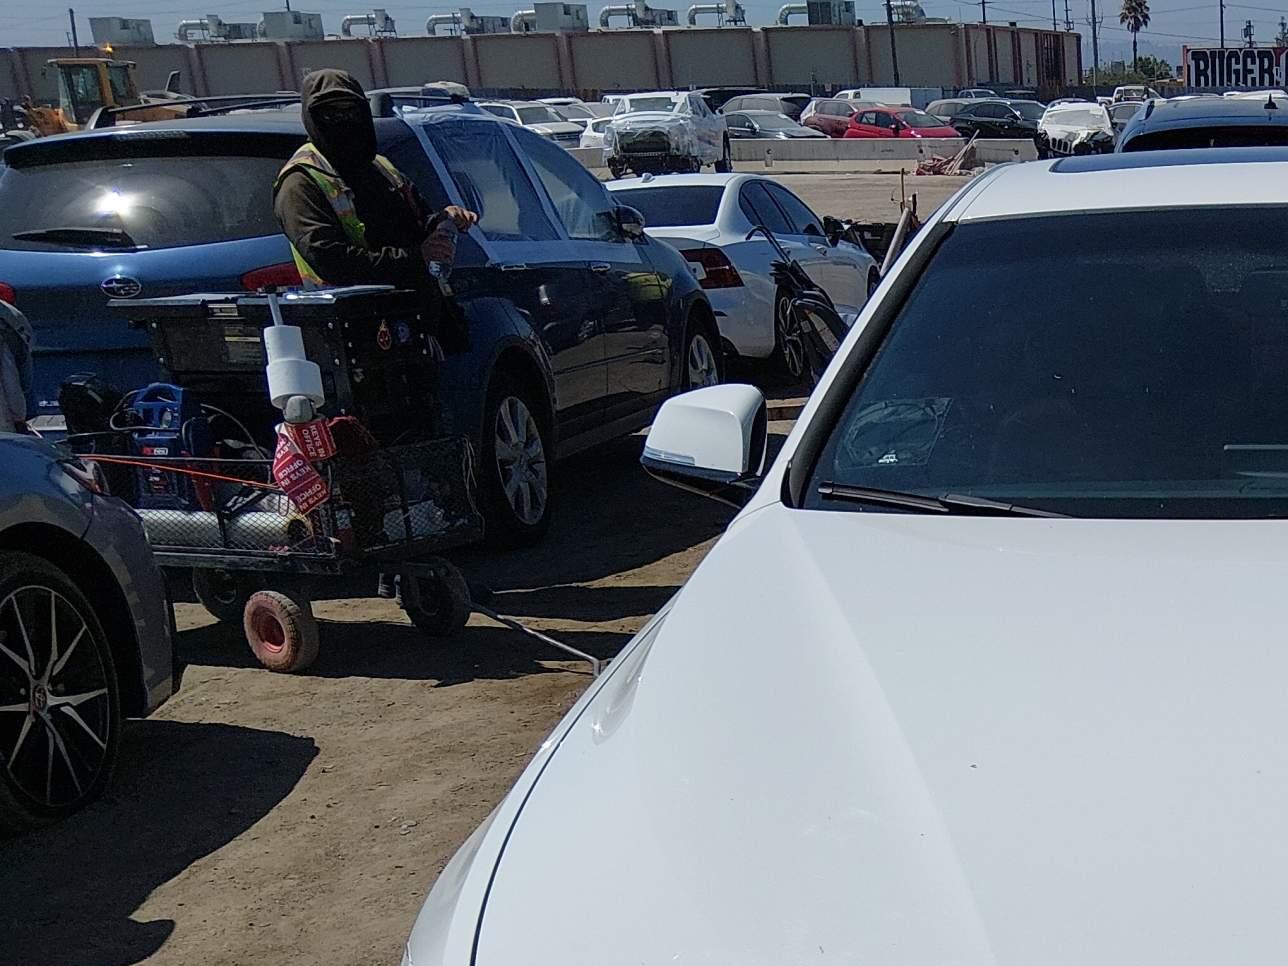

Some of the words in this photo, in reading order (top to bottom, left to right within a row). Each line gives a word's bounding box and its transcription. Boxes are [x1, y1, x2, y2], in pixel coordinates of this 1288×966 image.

[302, 429, 317, 457] OFFICE
[309, 424, 322, 447] KEYS
[317, 447, 326, 458] IN
[278, 459, 304, 479] OFFICE
[290, 464, 313, 480] KEYS
[308, 489, 328, 503] KEYS
